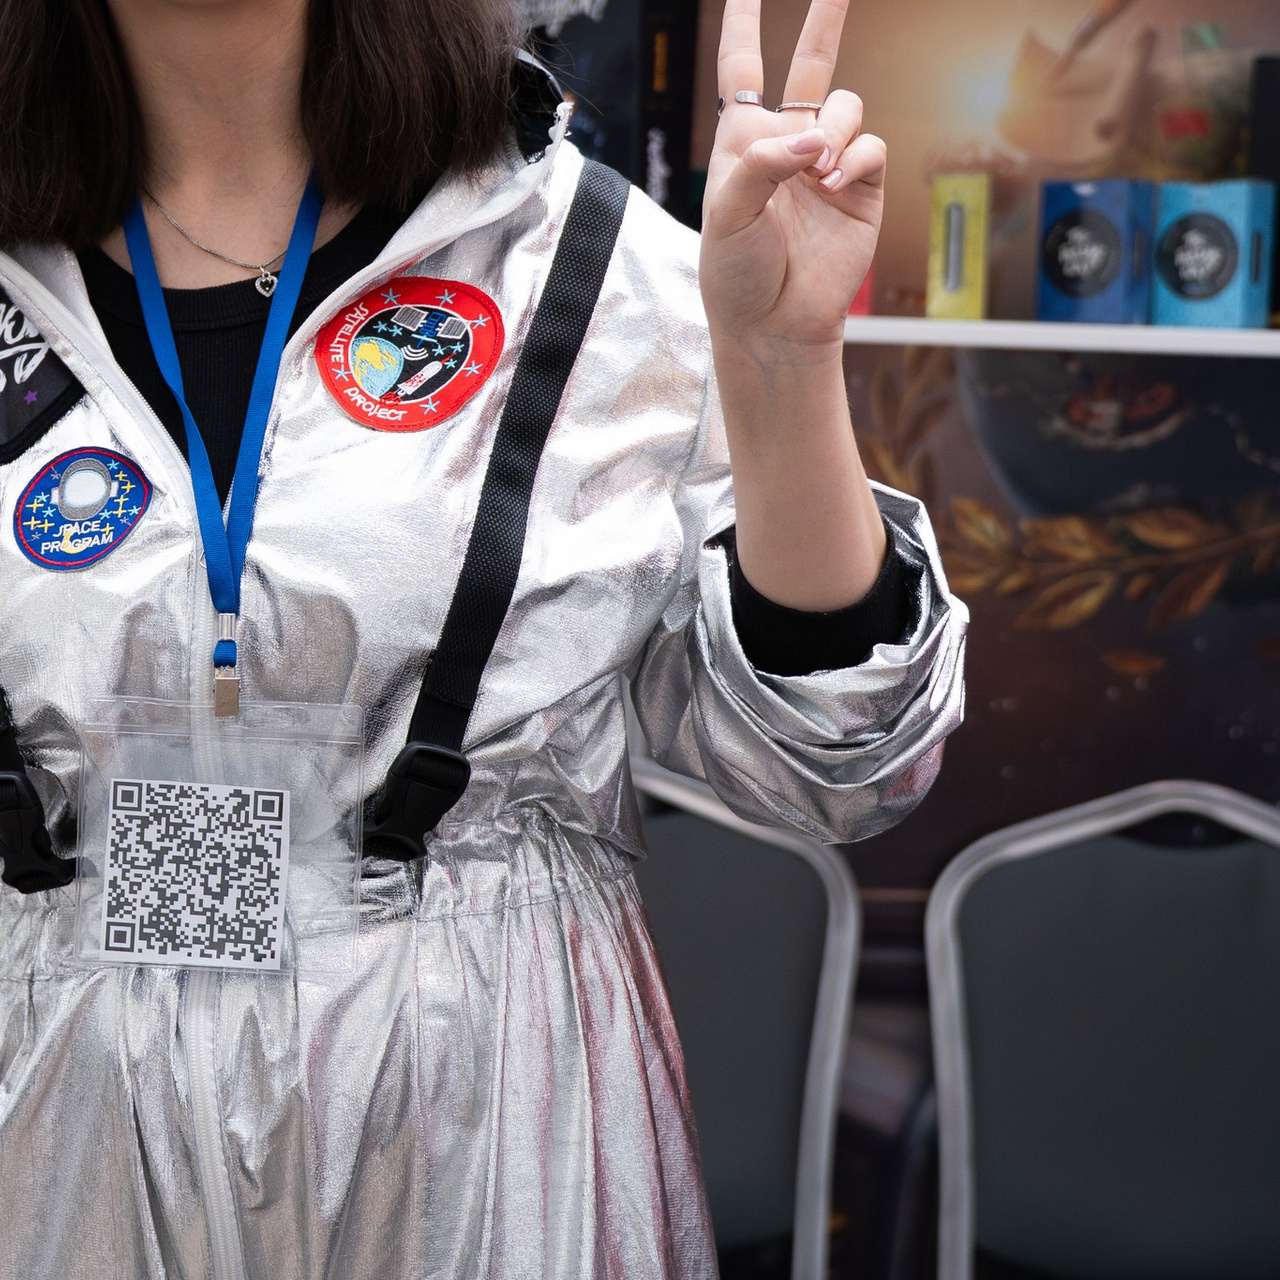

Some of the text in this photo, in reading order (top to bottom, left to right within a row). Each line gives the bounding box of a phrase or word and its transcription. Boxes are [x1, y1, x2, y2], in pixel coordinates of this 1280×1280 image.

[329, 302, 369, 363] SATELLITE
[344, 386, 408, 421] PROJECT
[40, 531, 114, 555] PROGRAM
[52, 520, 101, 538] SPACE
